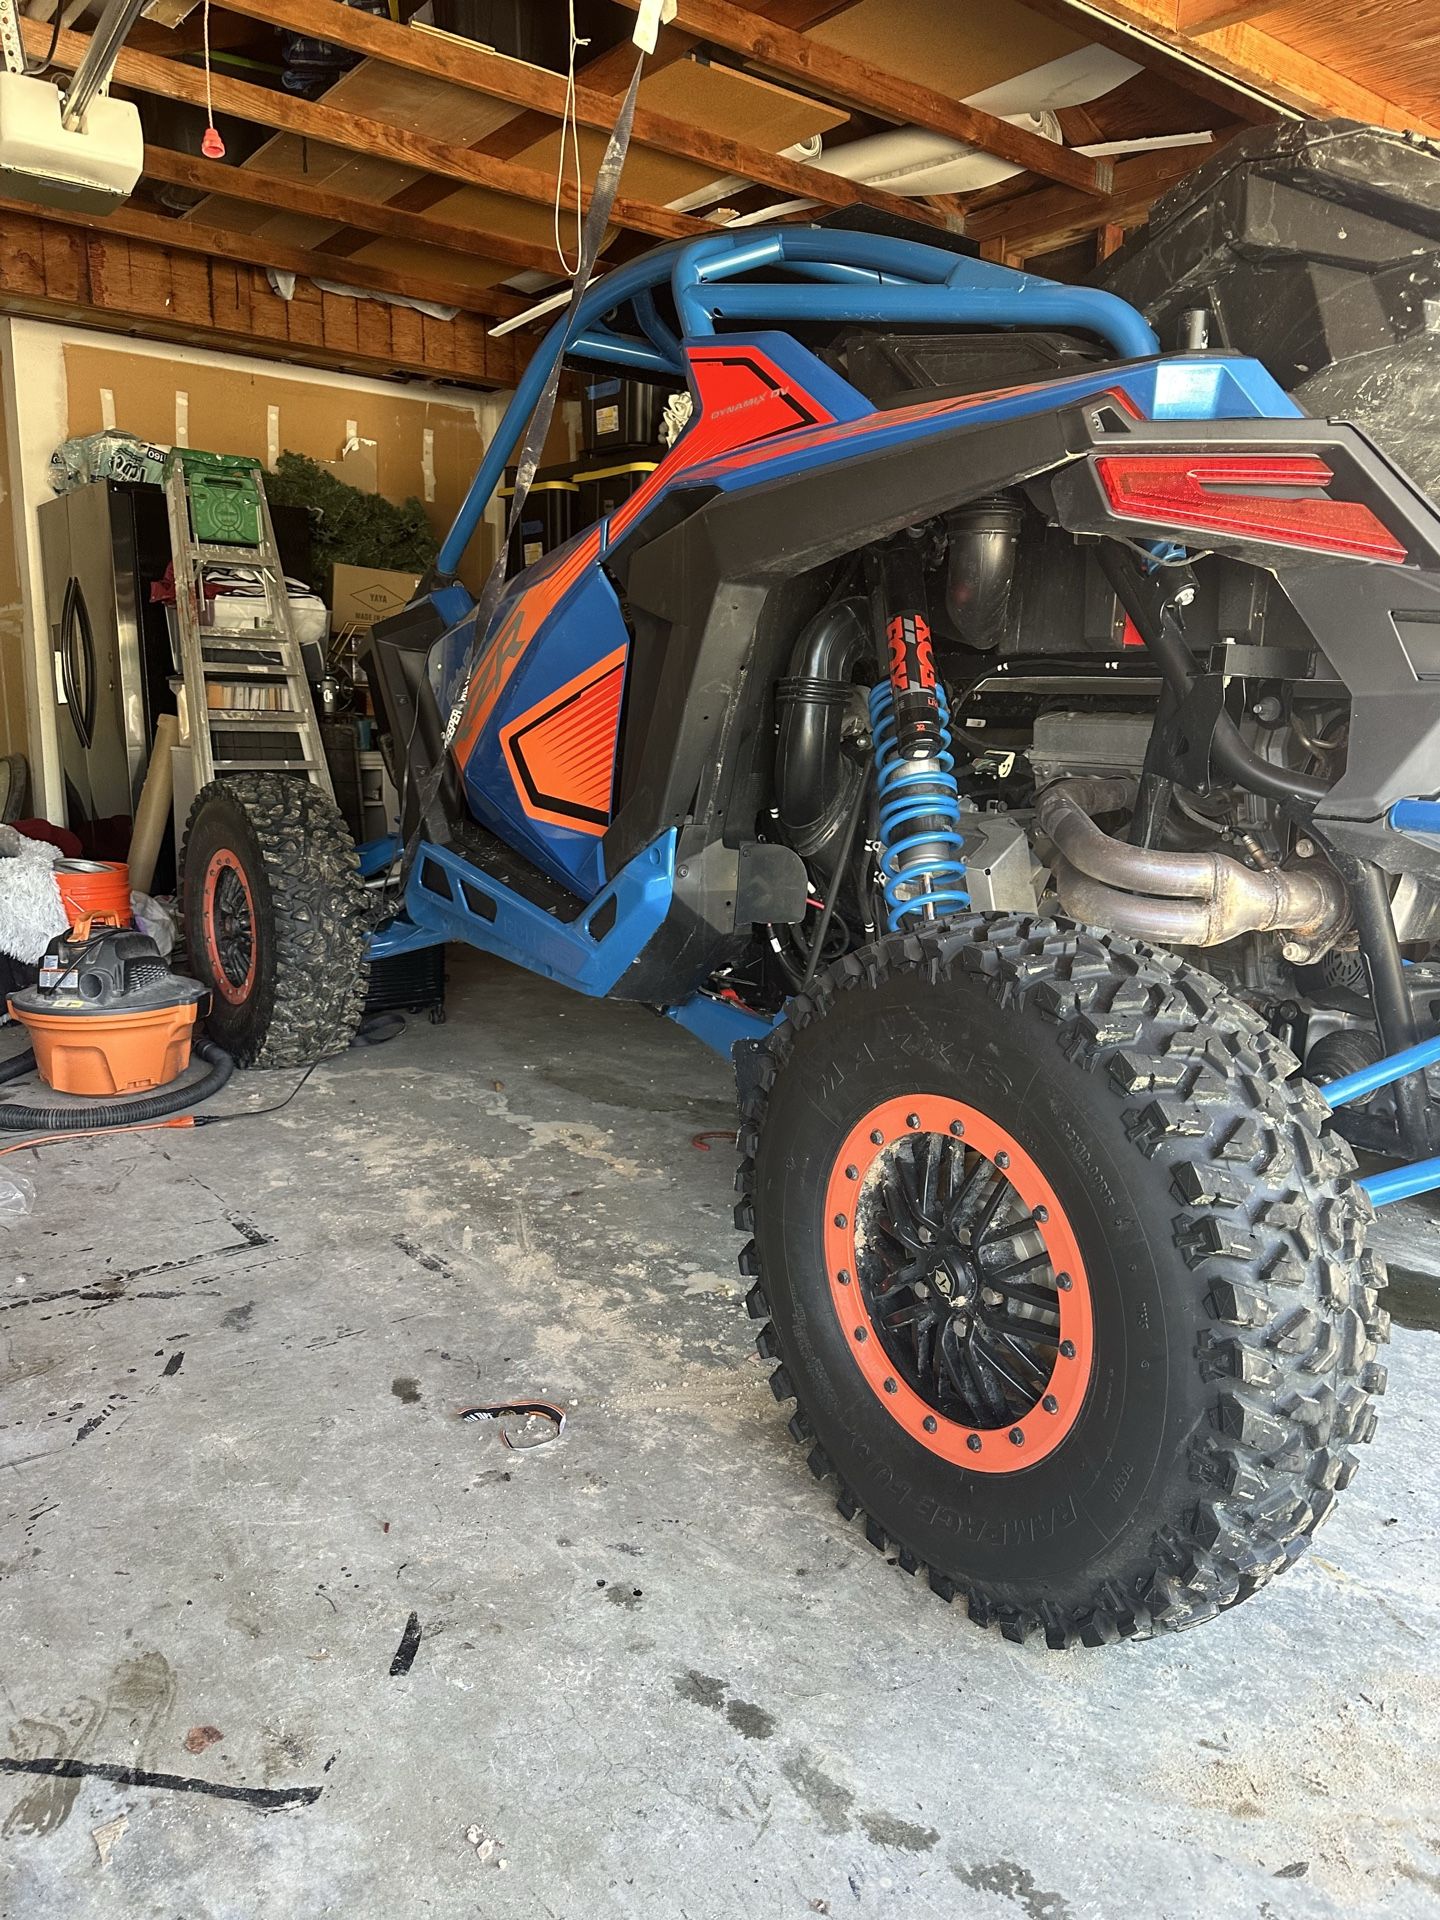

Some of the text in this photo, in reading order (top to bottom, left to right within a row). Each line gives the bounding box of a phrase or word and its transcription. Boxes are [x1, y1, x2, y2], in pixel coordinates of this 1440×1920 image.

[711, 391, 767, 419] DYNAMIX
[148, 450, 164, 463] 160
[369, 592, 388, 603] YAYA
